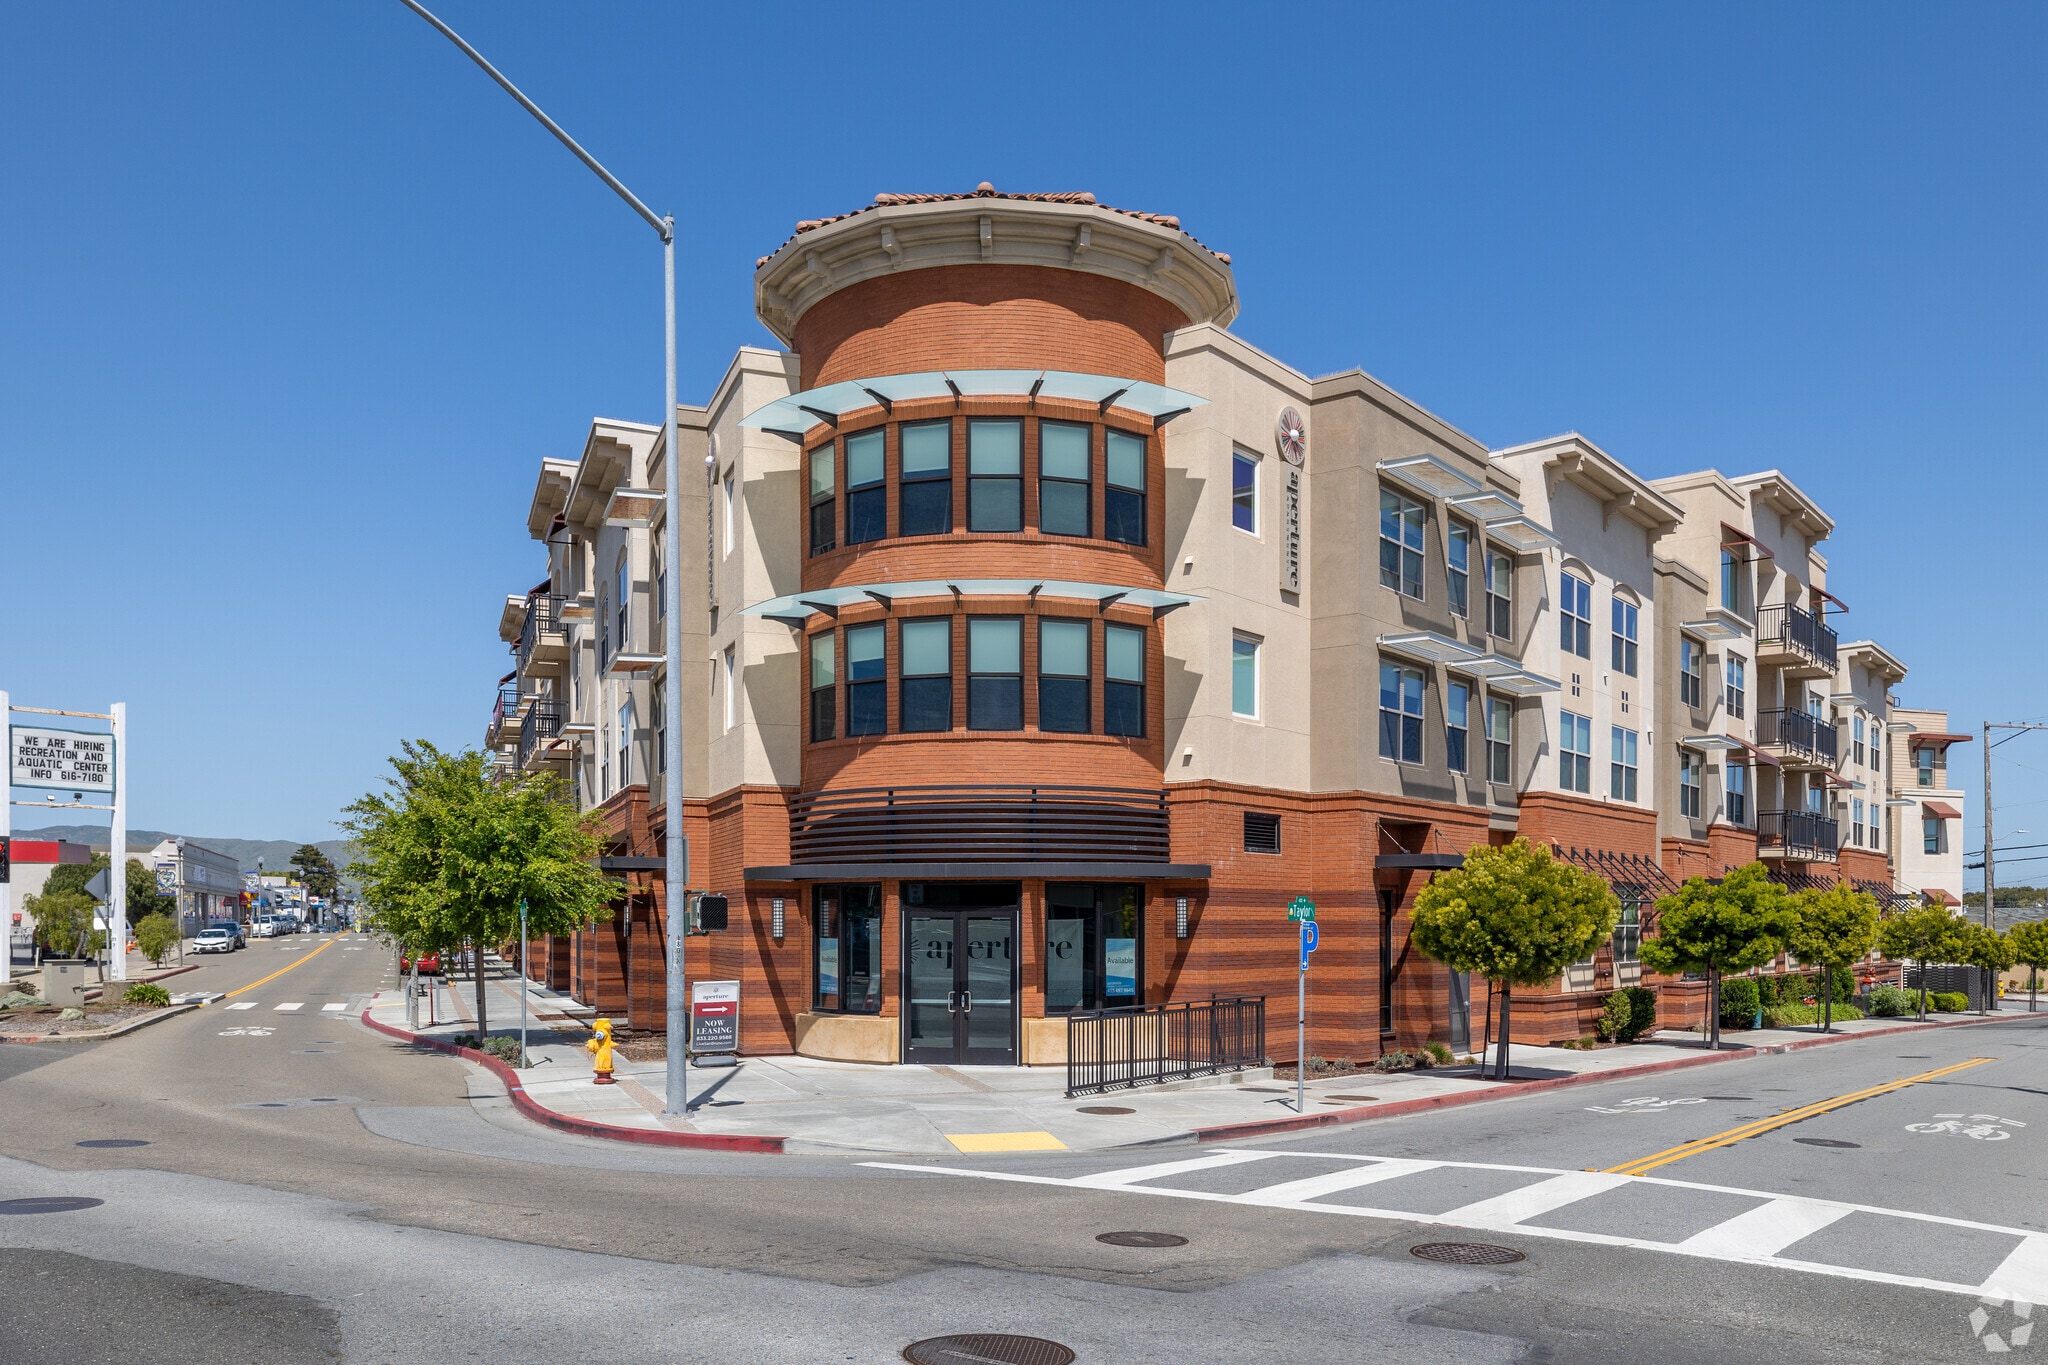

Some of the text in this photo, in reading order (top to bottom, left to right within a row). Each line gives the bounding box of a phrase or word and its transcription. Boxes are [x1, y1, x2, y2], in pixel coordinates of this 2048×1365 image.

[1286, 472, 1300, 588] aperture
[24, 736, 105, 752] WE ARE HIRING
[19, 747, 103, 762] RECREATION AND
[18, 758, 108, 773] AQUATIC CENTER
[30, 769, 104, 783] INFO 616-7180
[1293, 904, 1311, 919] Taylor
[696, 1026, 733, 1035] LEASING
[704, 1019, 725, 1027] NOW
